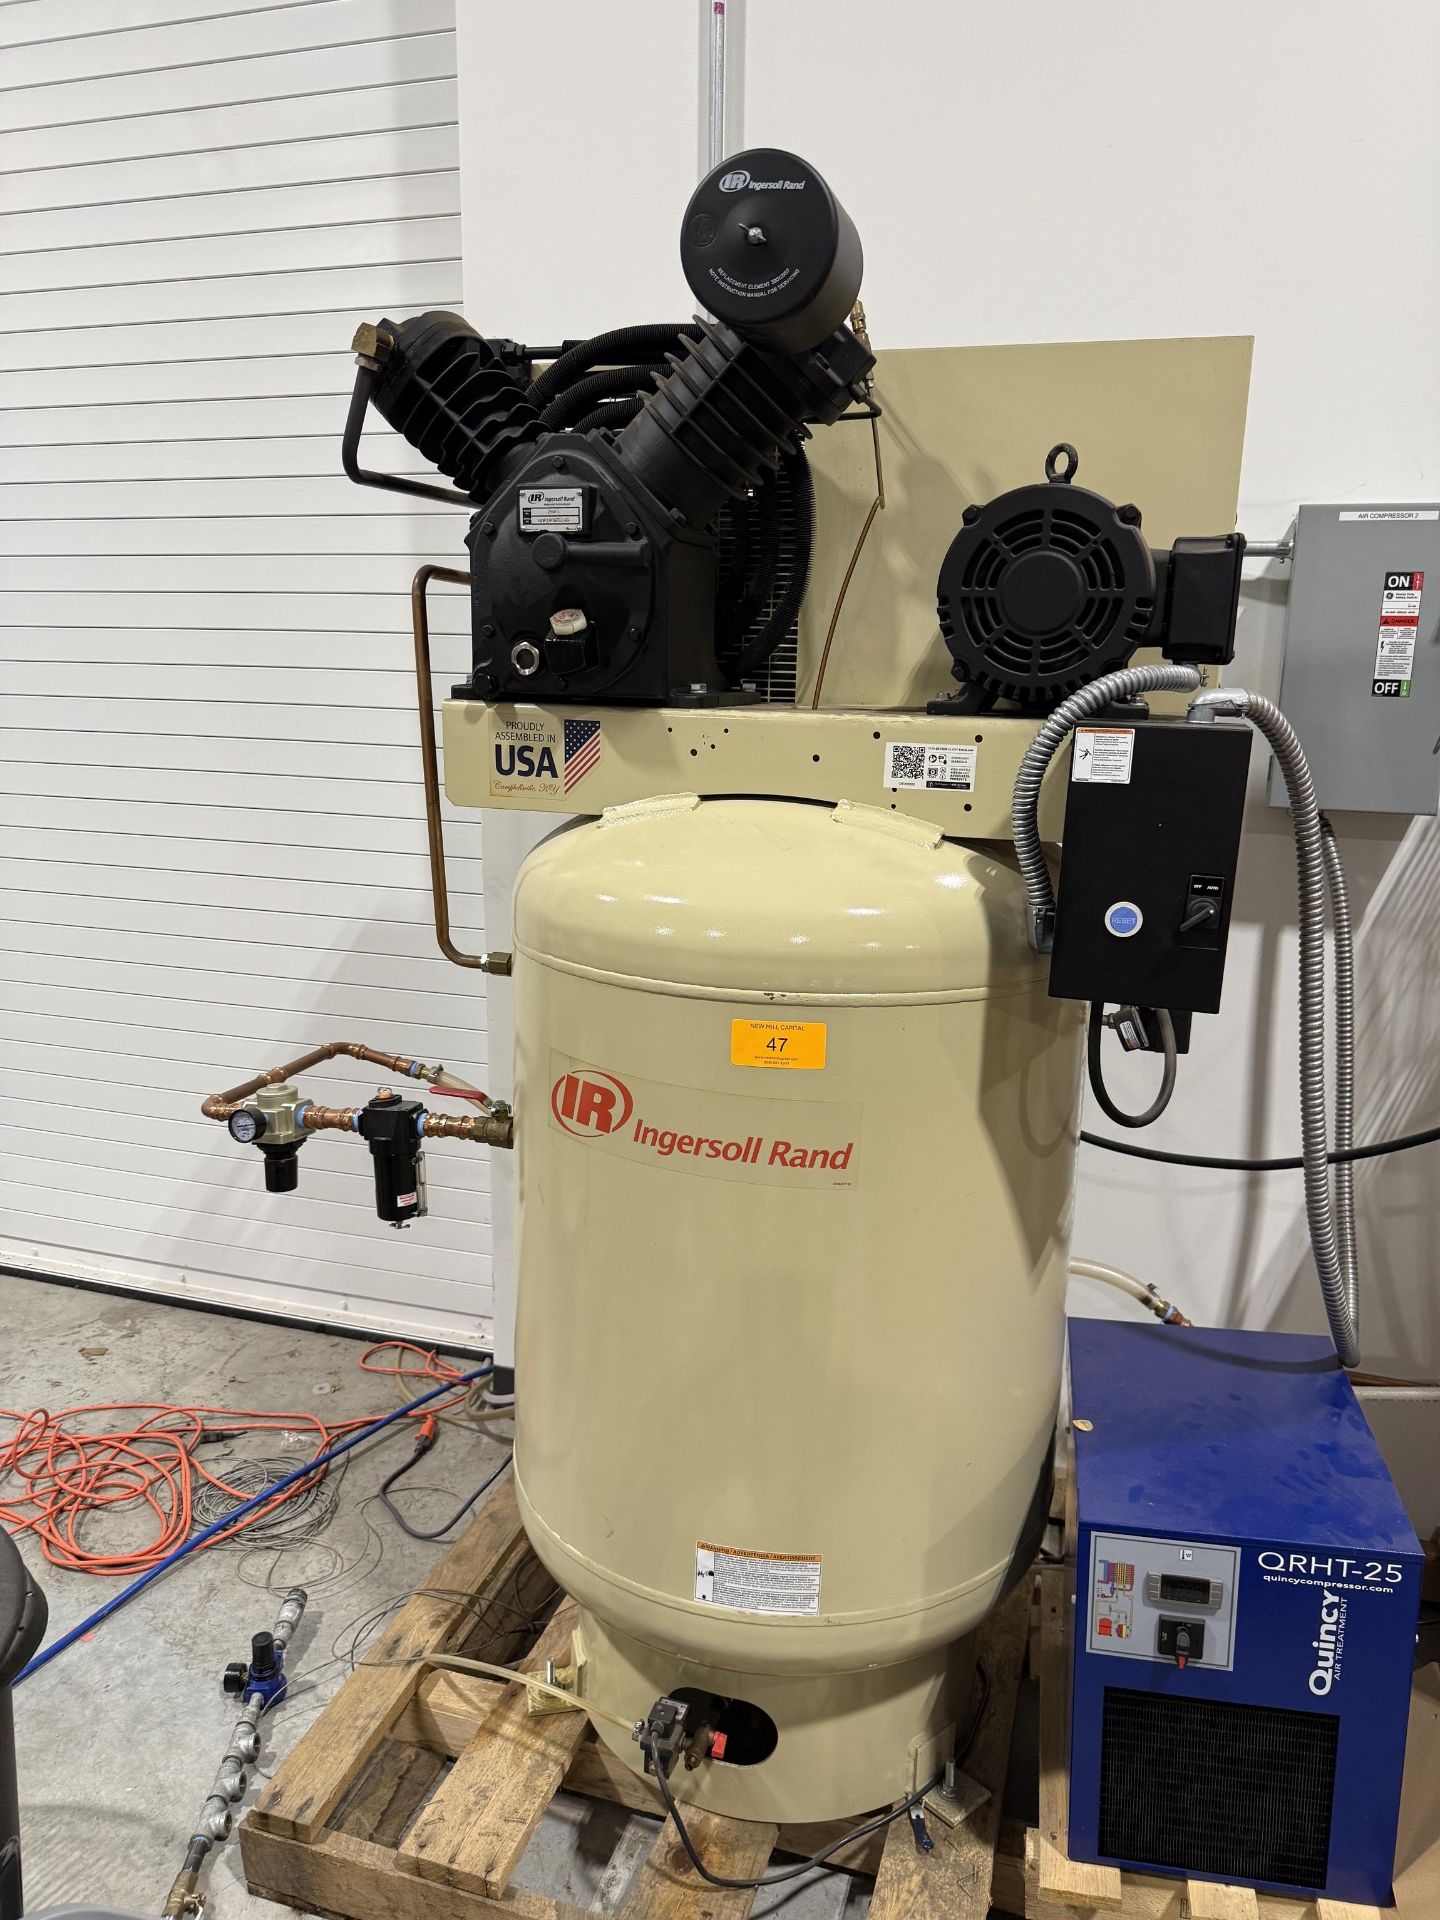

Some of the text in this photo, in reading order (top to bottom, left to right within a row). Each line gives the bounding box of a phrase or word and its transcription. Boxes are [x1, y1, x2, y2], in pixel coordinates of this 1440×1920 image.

[723, 173, 746, 189] IR
[748, 180, 806, 191] Ingersoll Rand
[717, 267, 770, 290] REPLACEMENT ELEMENT
[717, 279, 747, 297] INSTRUCTION
[746, 290, 768, 298] MANUAL
[767, 286, 779, 295] FOR
[777, 268, 800, 290] SERVICING
[1387, 575, 1410, 588] ON
[1374, 681, 1399, 694] OFF
[506, 720, 545, 731] PROUDLY
[495, 731, 556, 743] ASSEMBLED IN
[495, 743, 559, 778] USA
[780, 1024, 806, 1032] CAPITAL
[766, 1037, 788, 1052] 47
[561, 1073, 617, 1134] IR
[632, 1118, 854, 1170] Ingersoll Rand
[706, 1543, 729, 1554] WARNING
[1257, 1551, 1403, 1583] QRHT-25
[1263, 1575, 1394, 1594] quincycompressor.com
[1308, 1588, 1340, 1696] Quincy
[1333, 1597, 1348, 1681] AIR TREATMENT
